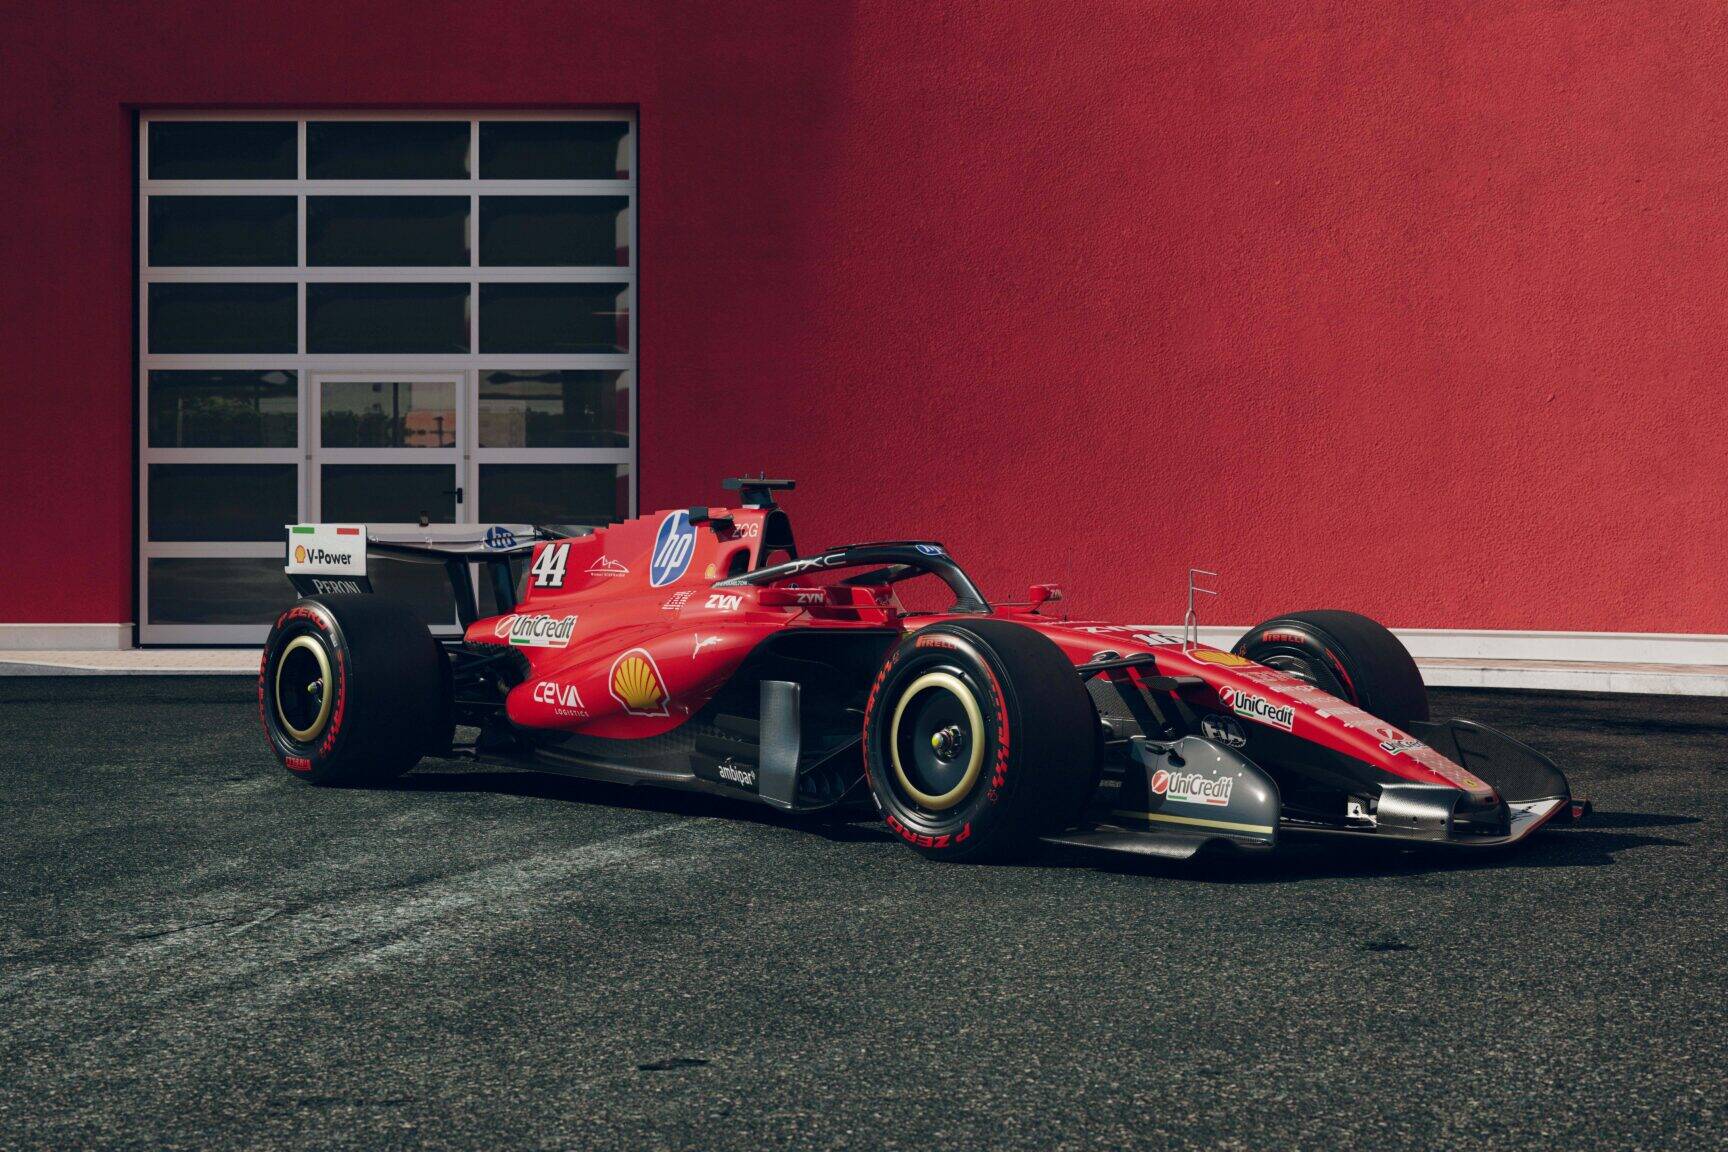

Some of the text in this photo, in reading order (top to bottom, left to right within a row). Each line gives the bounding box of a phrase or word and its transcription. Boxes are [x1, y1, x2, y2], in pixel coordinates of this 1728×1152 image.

[306, 548, 352, 565] V-Power
[653, 512, 693, 586] hp
[531, 543, 571, 587] 44
[312, 579, 362, 594] PERONI
[796, 593, 824, 604] ZYN
[705, 594, 743, 611] ZYN
[512, 616, 575, 639] UniCredit
[1235, 691, 1293, 726] UniCredit
[1168, 773, 1233, 799] UniCredit
[885, 815, 953, 849] ZERO
